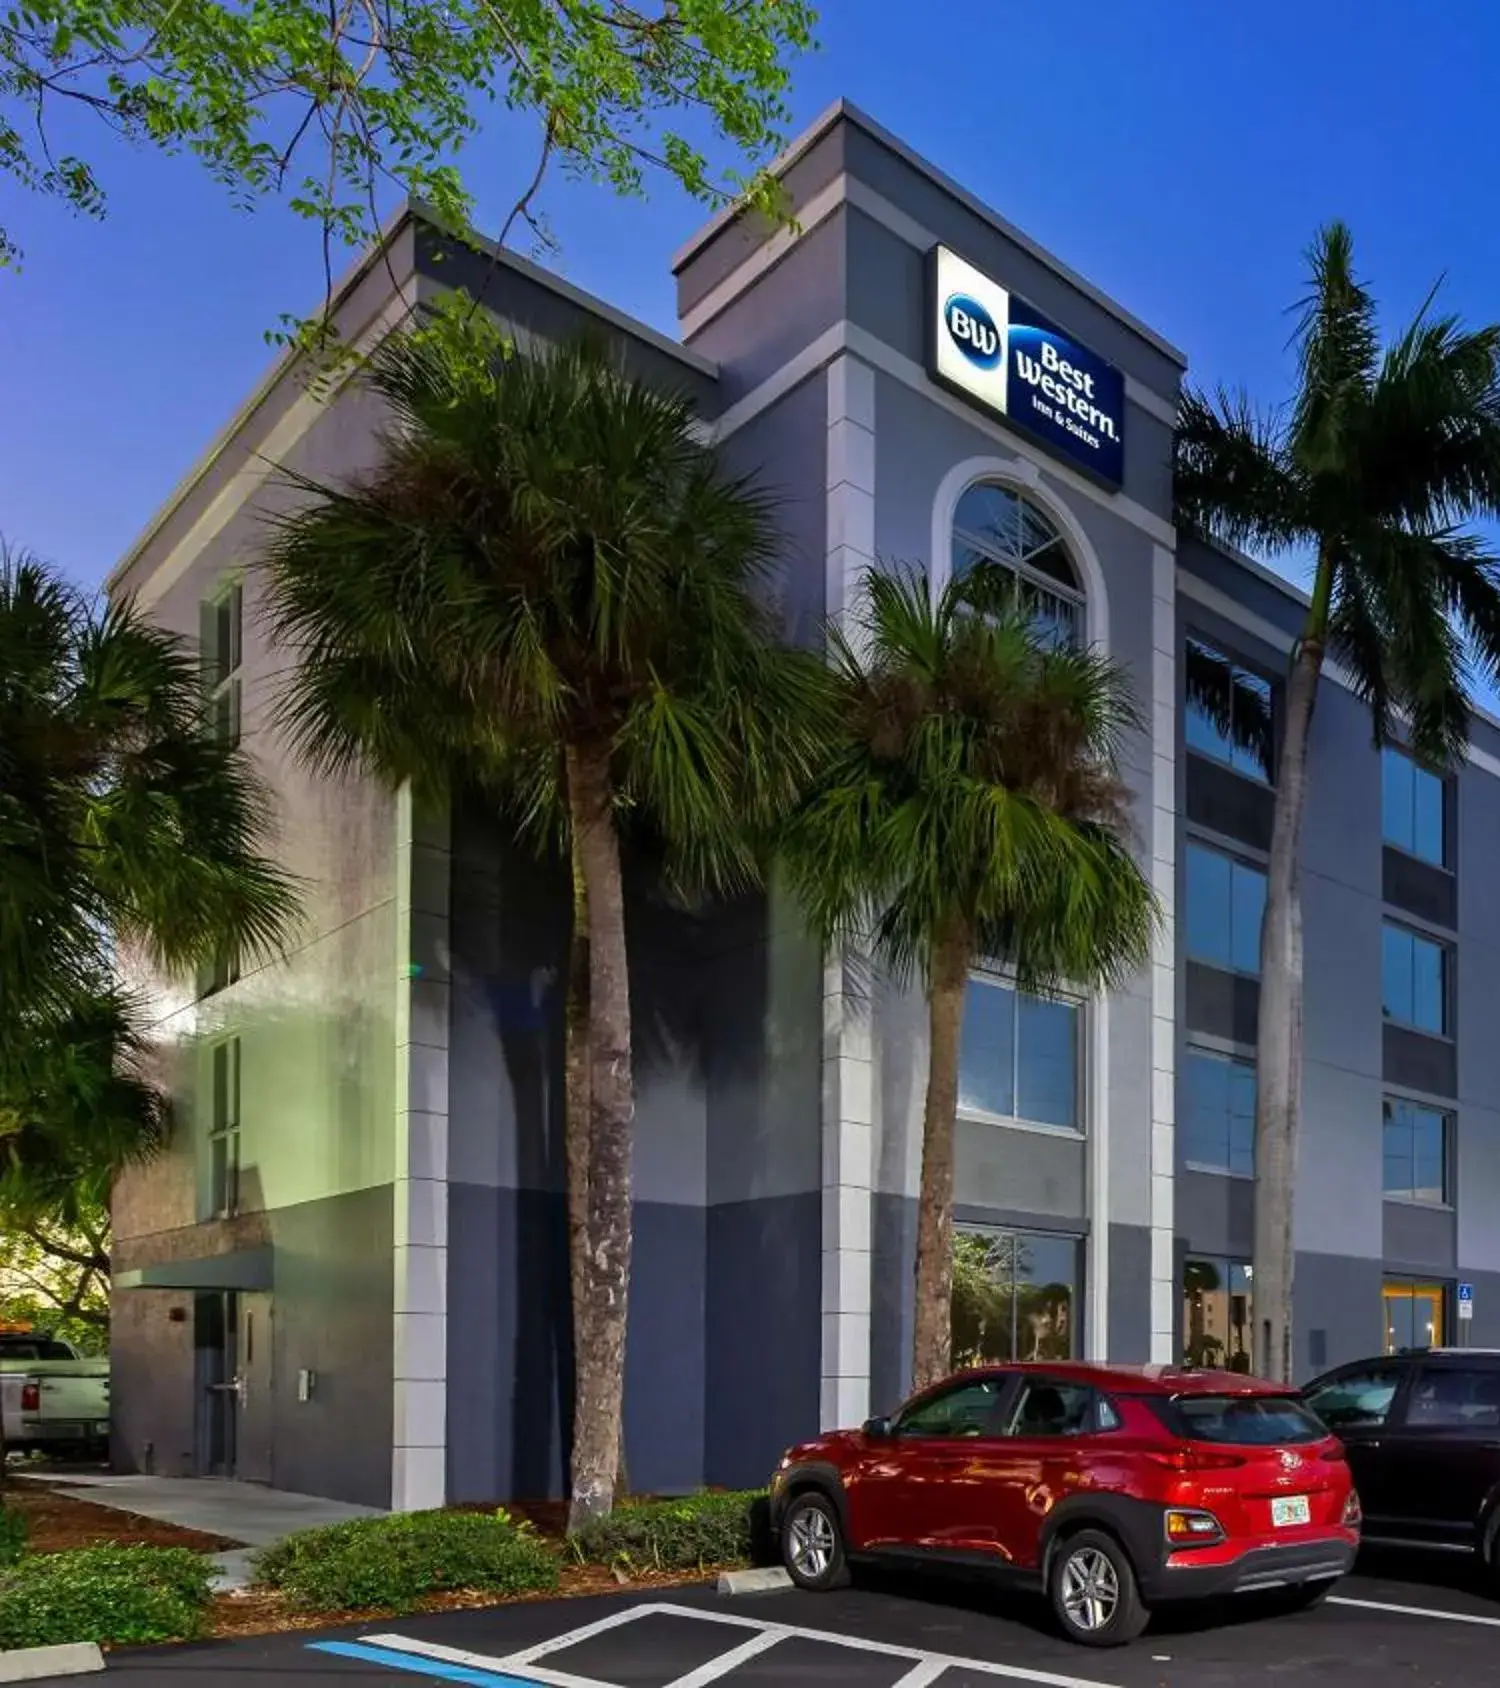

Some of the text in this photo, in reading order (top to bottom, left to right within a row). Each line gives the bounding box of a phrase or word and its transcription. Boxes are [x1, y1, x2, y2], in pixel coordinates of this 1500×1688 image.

[951, 307, 996, 355] BW
[1041, 341, 1094, 399] Best
[1032, 395, 1100, 449] Inn & Suites
